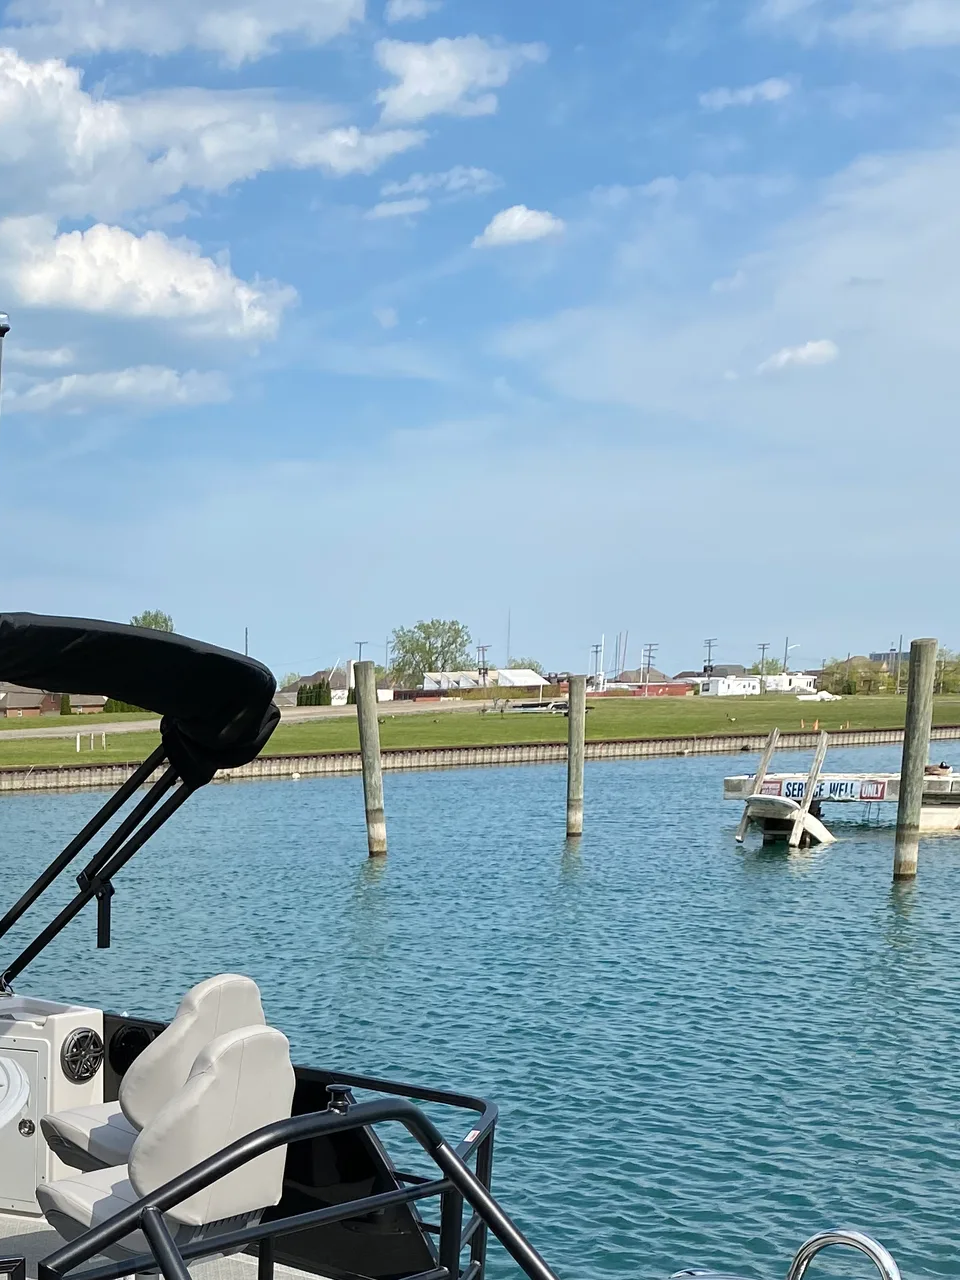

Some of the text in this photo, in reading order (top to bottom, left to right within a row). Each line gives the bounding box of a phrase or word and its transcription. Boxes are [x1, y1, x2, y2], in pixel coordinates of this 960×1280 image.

[785, 782, 825, 798] SERCE
[829, 782, 855, 798] WELL
[861, 782, 884, 799] ONLY
